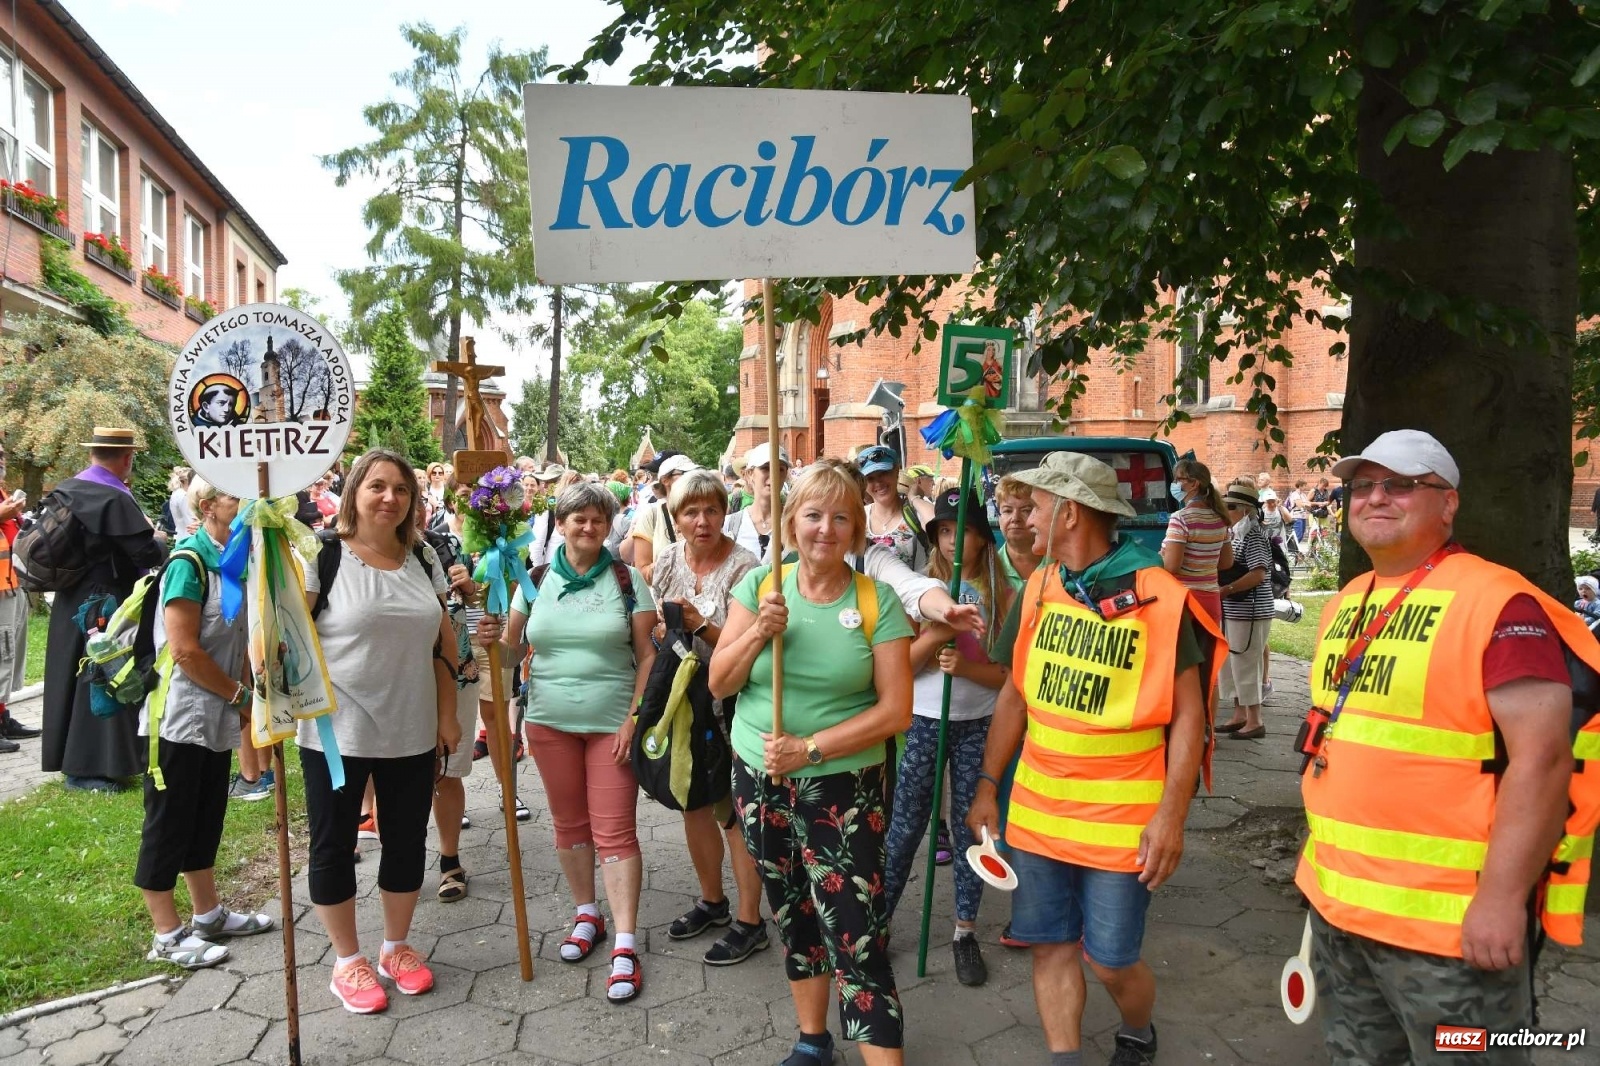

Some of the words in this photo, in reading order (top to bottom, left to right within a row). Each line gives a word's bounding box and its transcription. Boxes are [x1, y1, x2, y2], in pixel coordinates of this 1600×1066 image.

[549, 135, 966, 236] Racibórz
[173, 368, 191, 433] PARAFIA
[184, 313, 249, 365] ŚWIĘTEGO
[253, 312, 324, 348] TOMASZA
[321, 347, 350, 425] APOSTOŁA
[950, 342, 986, 393] 5
[198, 425, 330, 460] KIETRZ
[1035, 611, 1140, 670] KIEROWANIE
[1037, 661, 1111, 716] RUCHEM
[1322, 653, 1397, 696] RHEM
